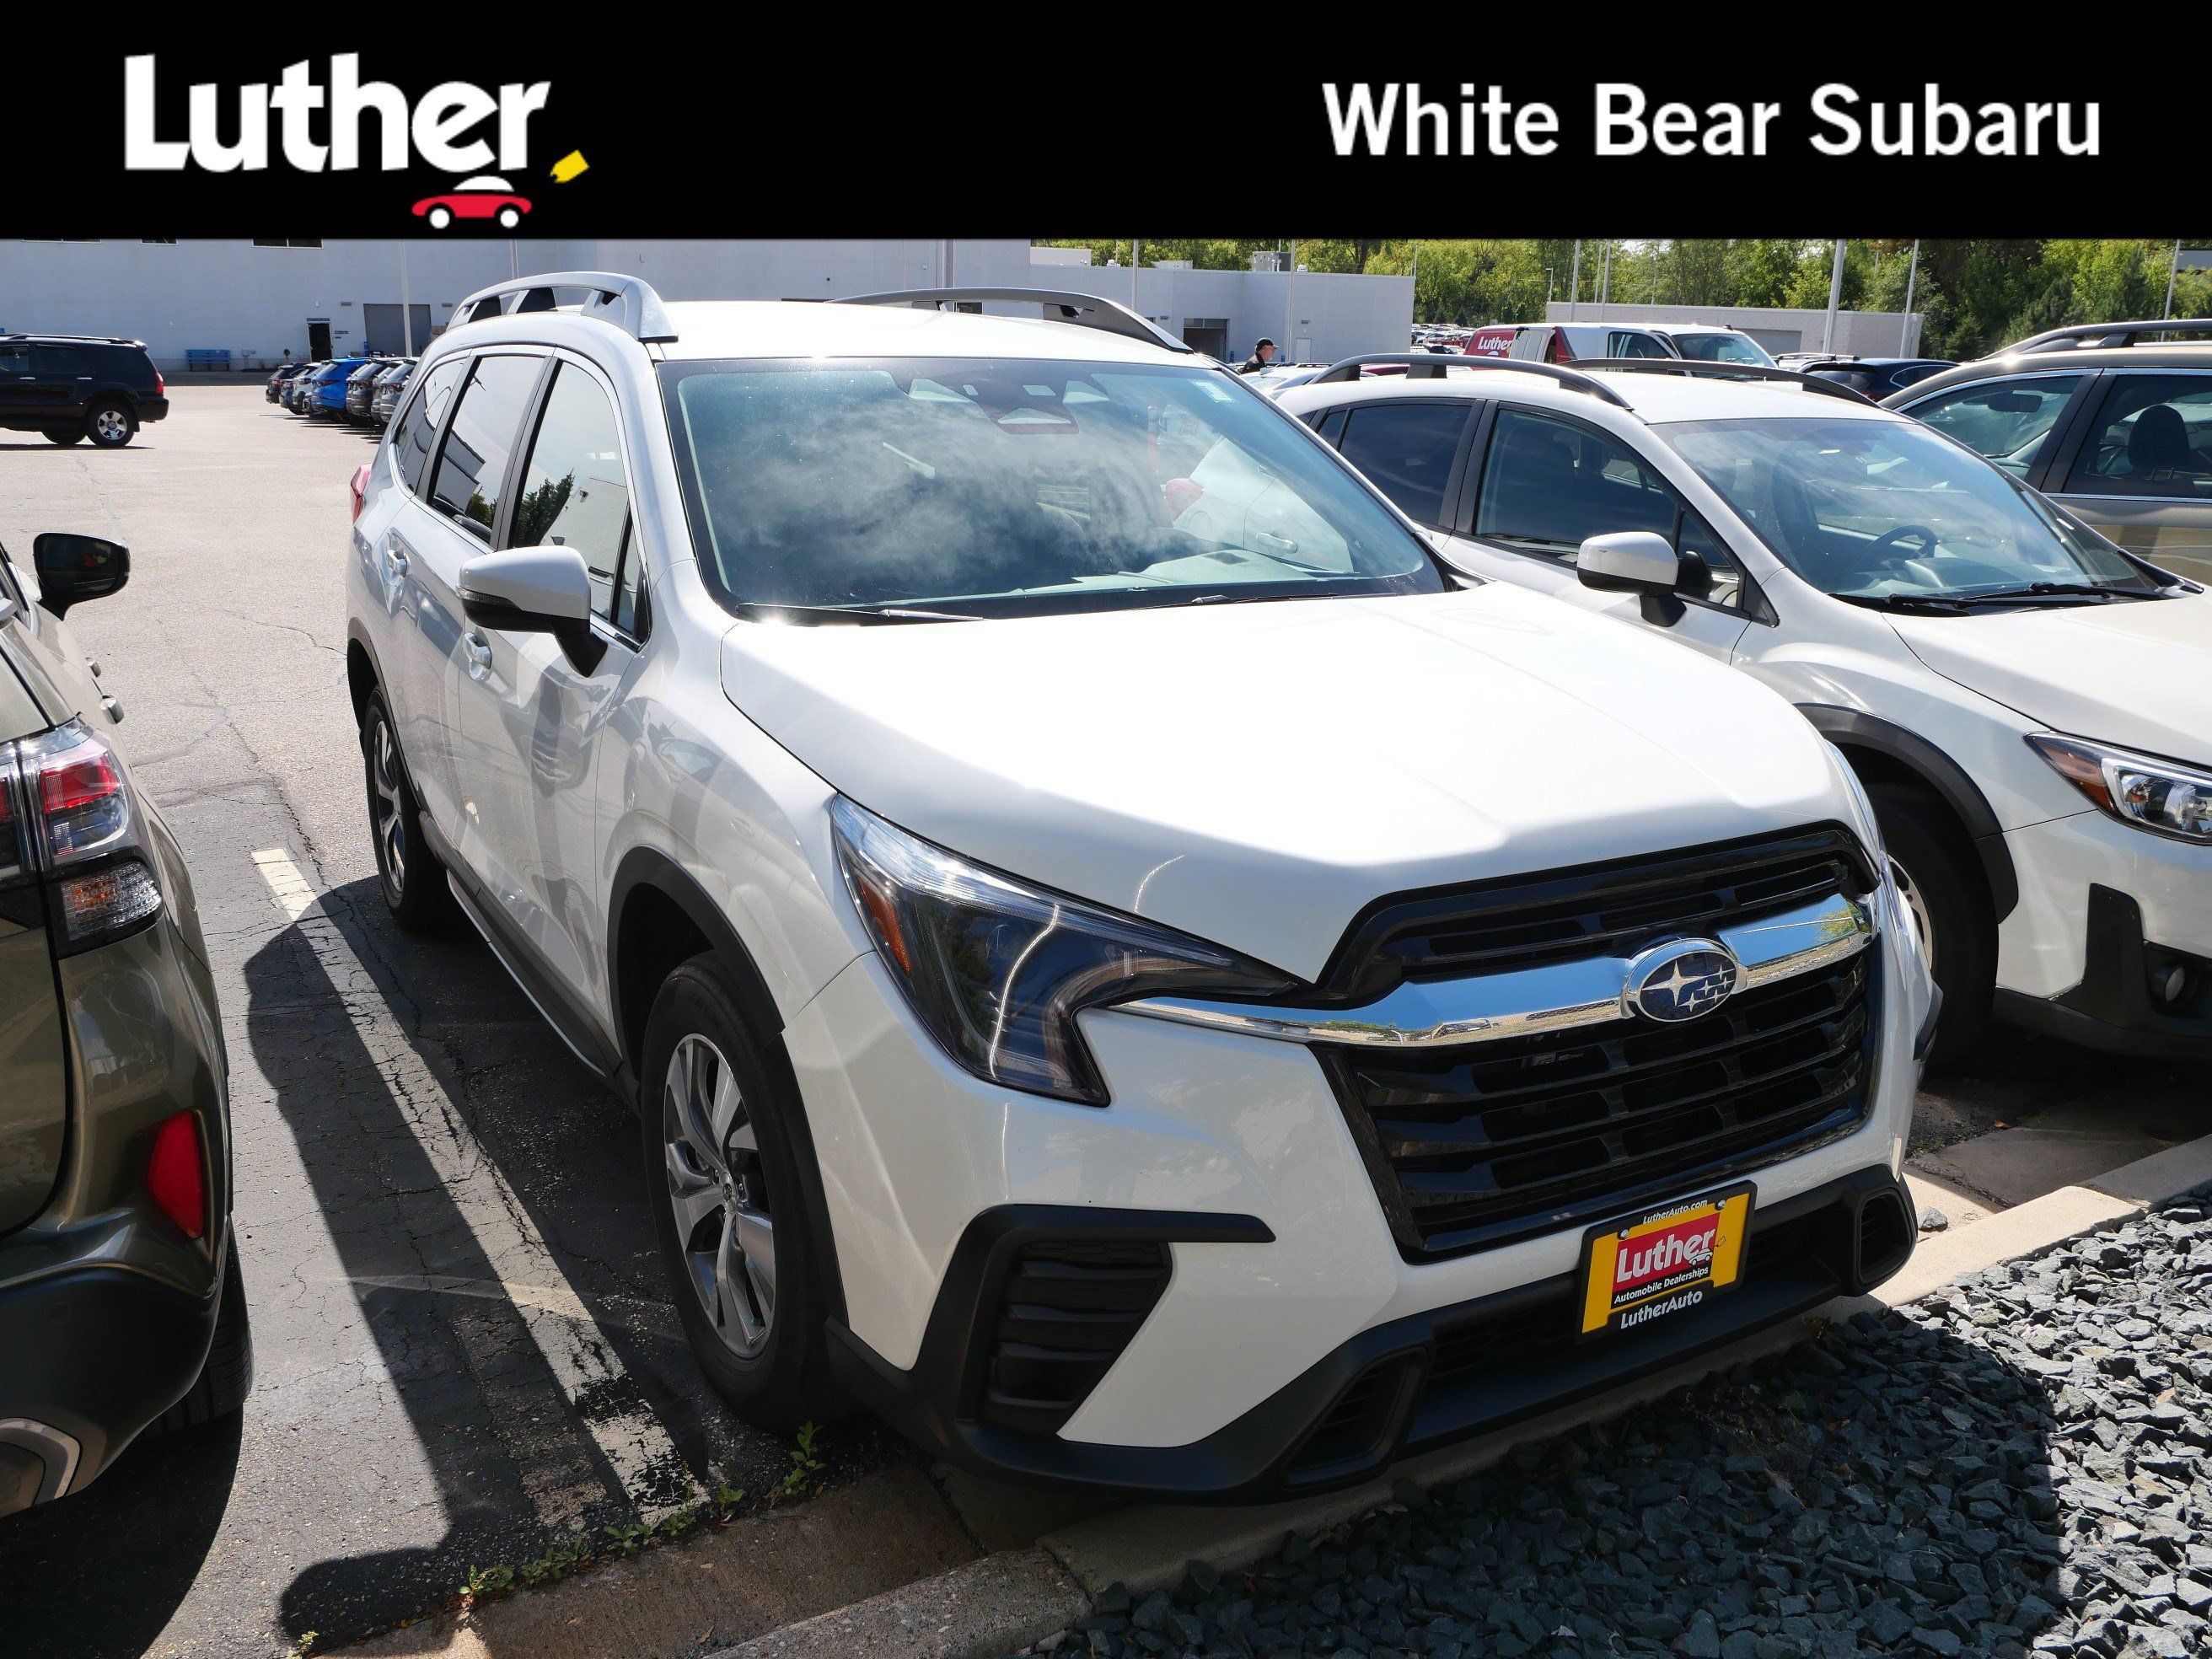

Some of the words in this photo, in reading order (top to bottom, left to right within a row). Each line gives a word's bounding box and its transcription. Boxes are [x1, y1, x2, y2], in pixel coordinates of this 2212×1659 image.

[1478, 336, 1512, 350] Luther
[1643, 1199, 1708, 1224] LutherAuto.com
[1617, 1228, 1716, 1283] Luther
[1613, 1280, 1662, 1304] Automobile
[1663, 1265, 1709, 1288] Dealerships
[1620, 1291, 1703, 1329] LutherAuto
